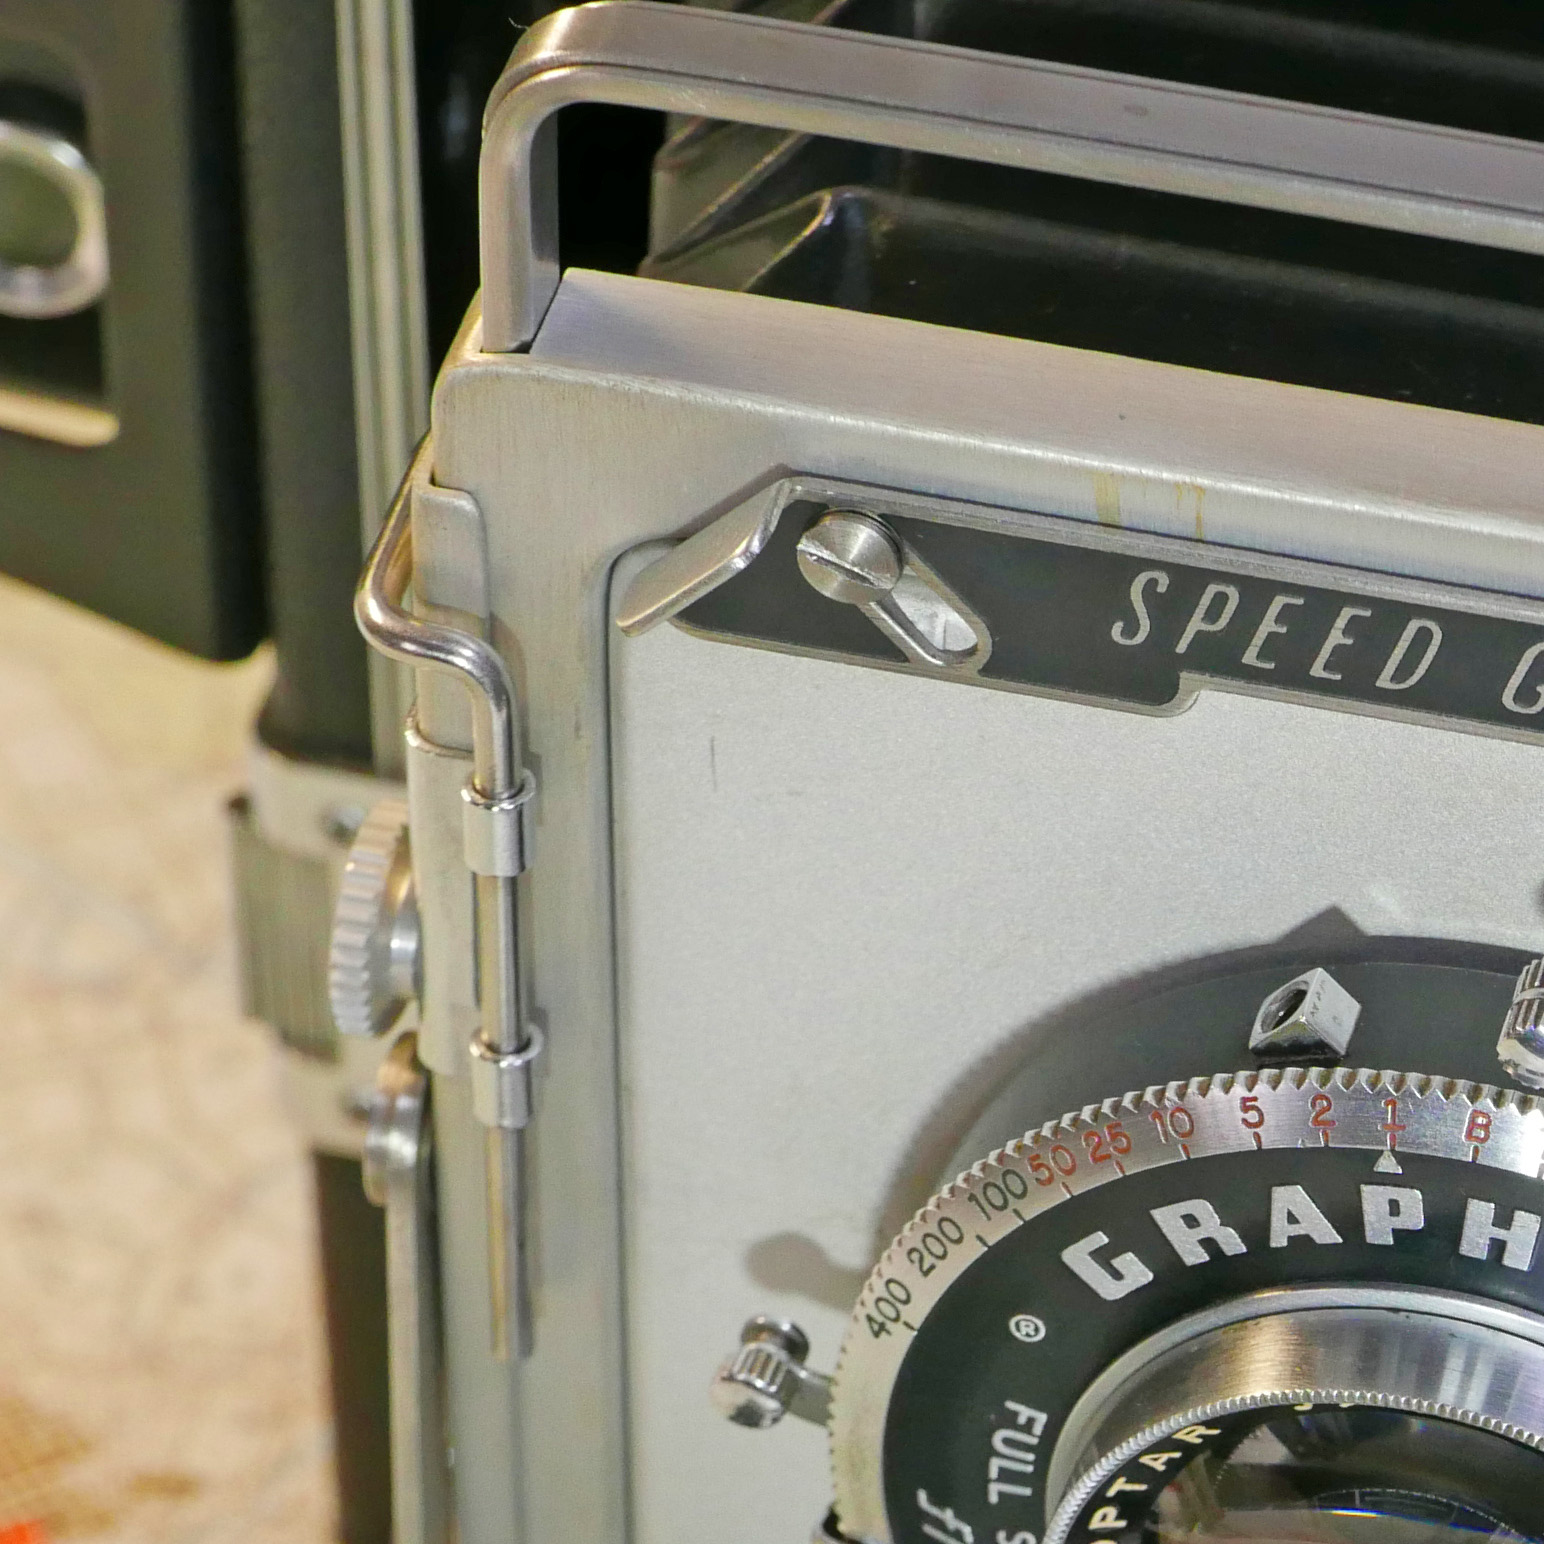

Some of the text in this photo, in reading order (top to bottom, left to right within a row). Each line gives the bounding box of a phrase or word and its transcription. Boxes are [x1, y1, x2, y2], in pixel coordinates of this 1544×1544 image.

[1110, 569, 1443, 691] SPEED
[865, 1277, 912, 1339] 400
[906, 1216, 965, 1278] 200
[967, 1166, 1029, 1221] 100
[1027, 1144, 1077, 1187] 50
[1082, 1121, 1132, 1165] 25
[1148, 1105, 1195, 1144] 10
[1239, 1095, 1265, 1130] 5
[1308, 1092, 1337, 1129] 2
[1377, 1097, 1407, 1132] 1
[1462, 1107, 1493, 1144] B
[987, 1399, 1049, 1505] FULL
